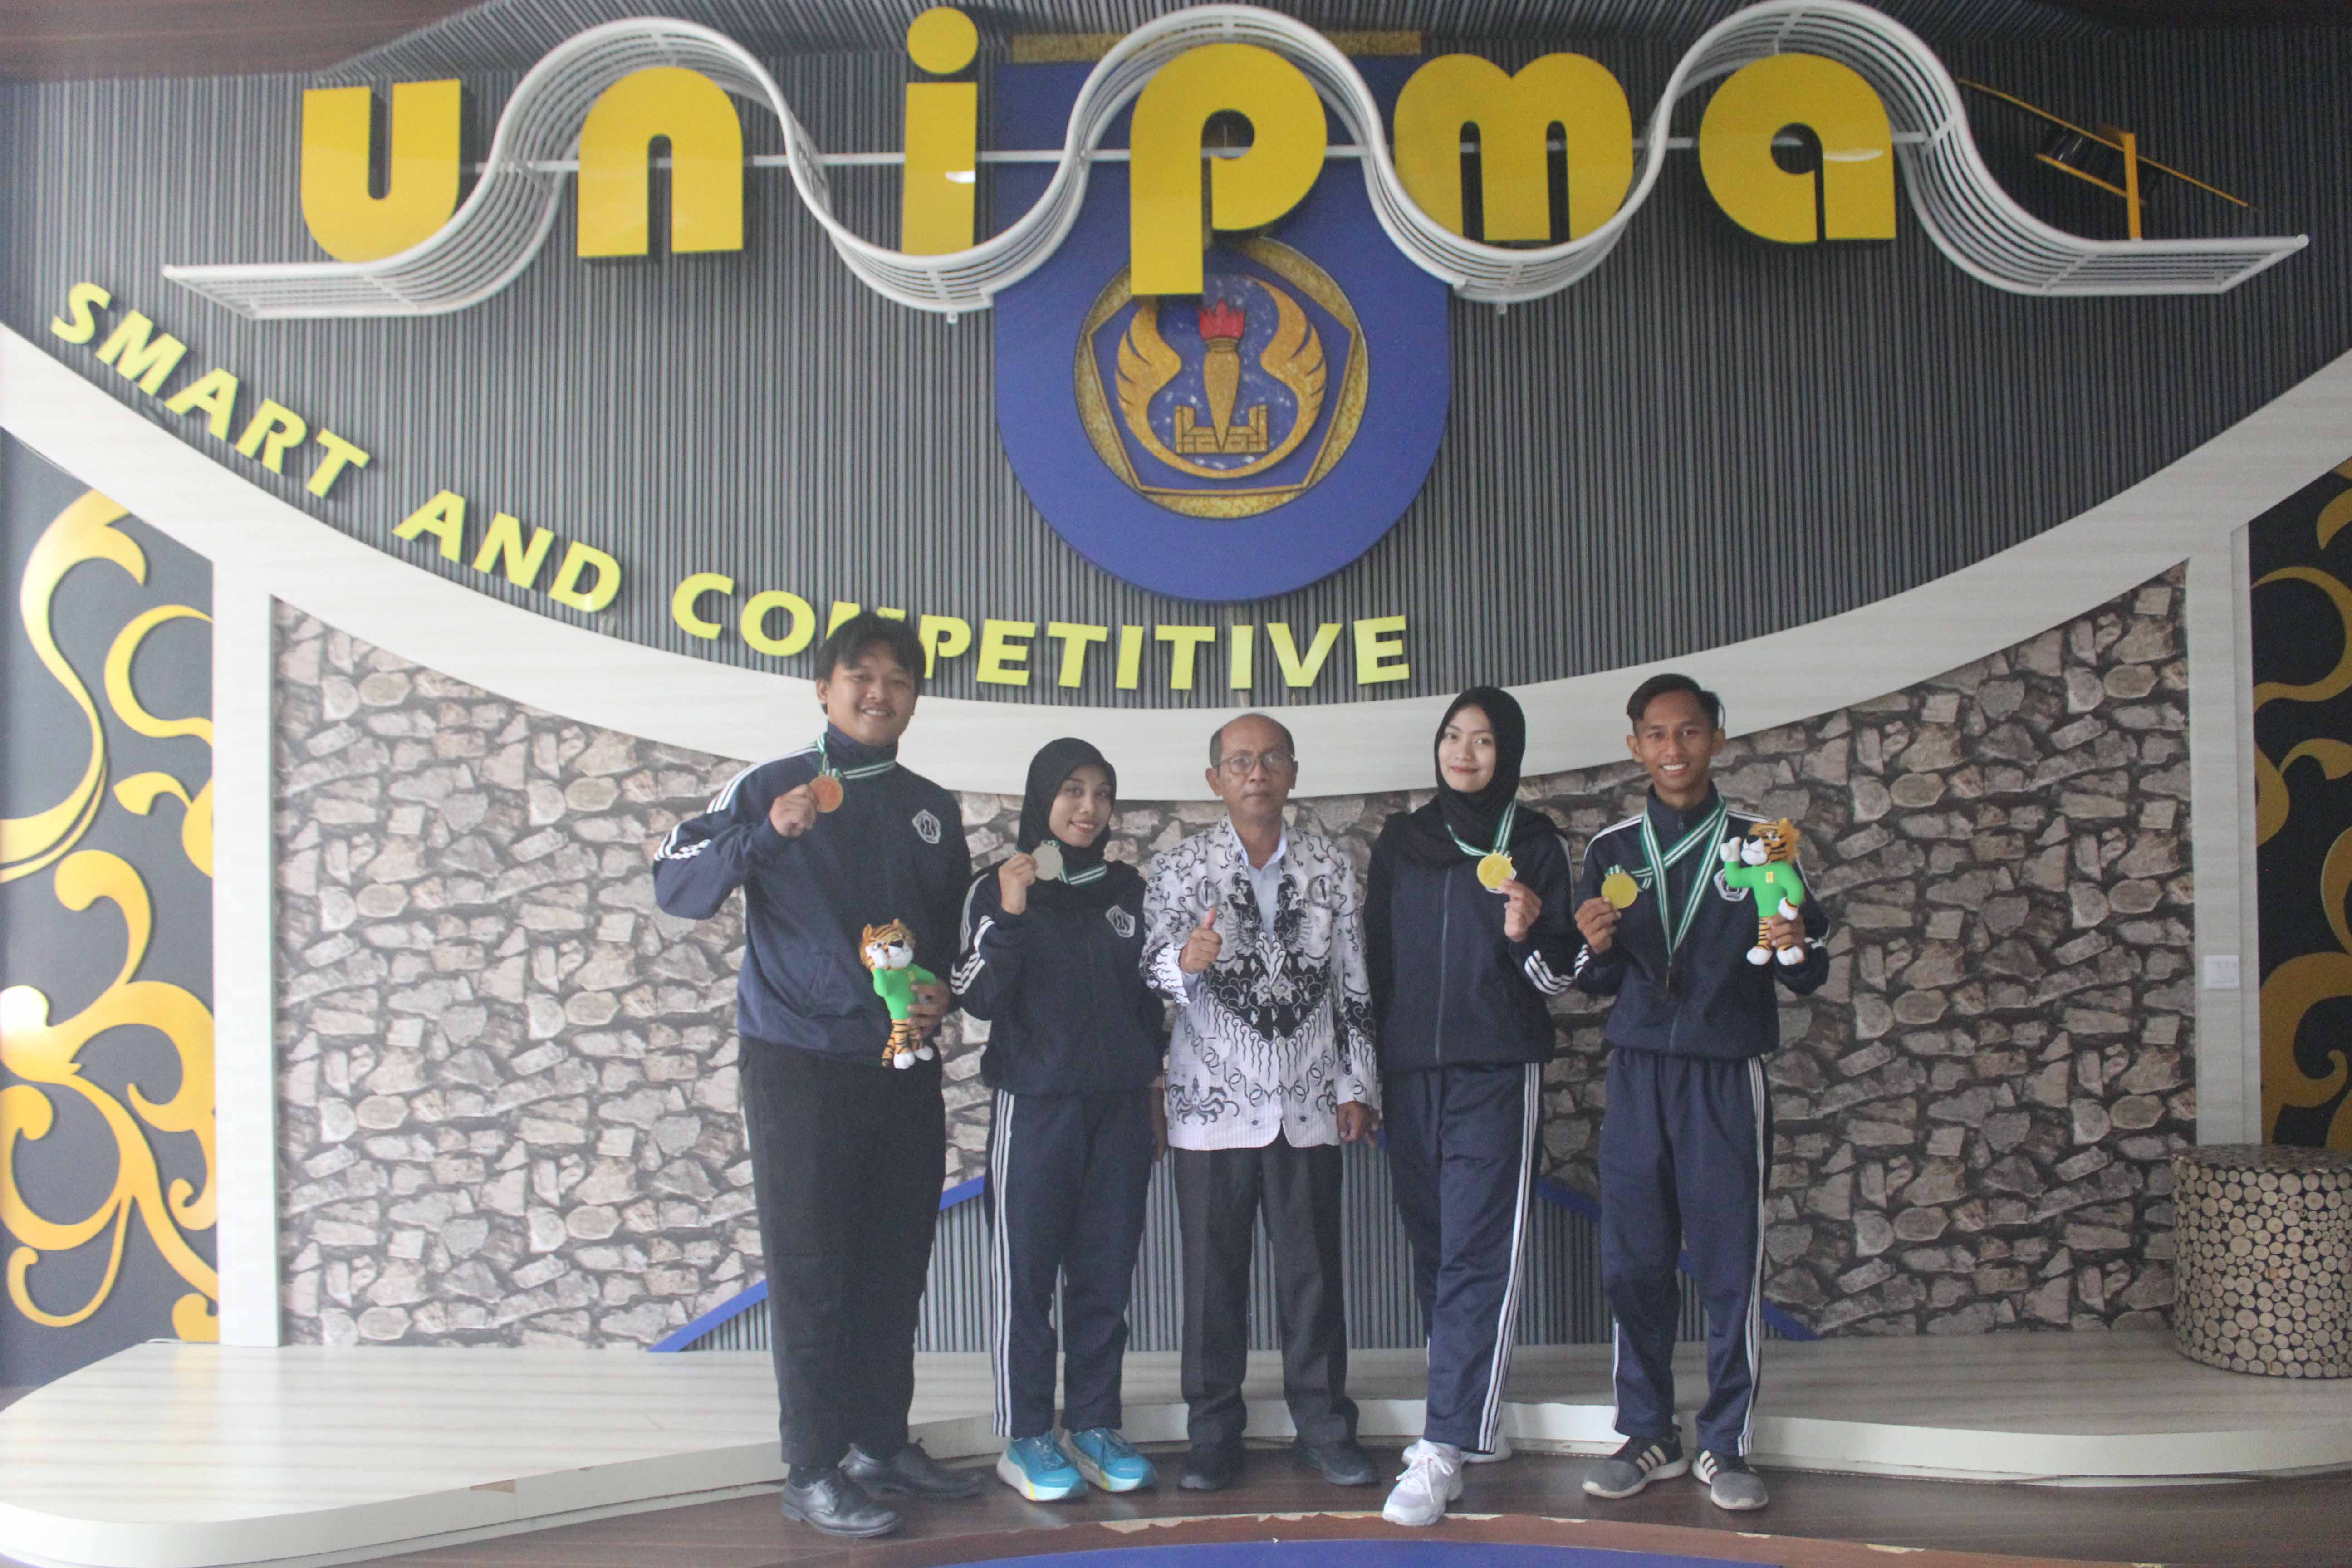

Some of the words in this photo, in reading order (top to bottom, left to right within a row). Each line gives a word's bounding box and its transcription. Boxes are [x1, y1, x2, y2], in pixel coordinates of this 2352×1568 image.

[51, 282, 370, 498] SMART
[392, 490, 622, 612] AND
[672, 572, 1410, 691] COPETITIVE
